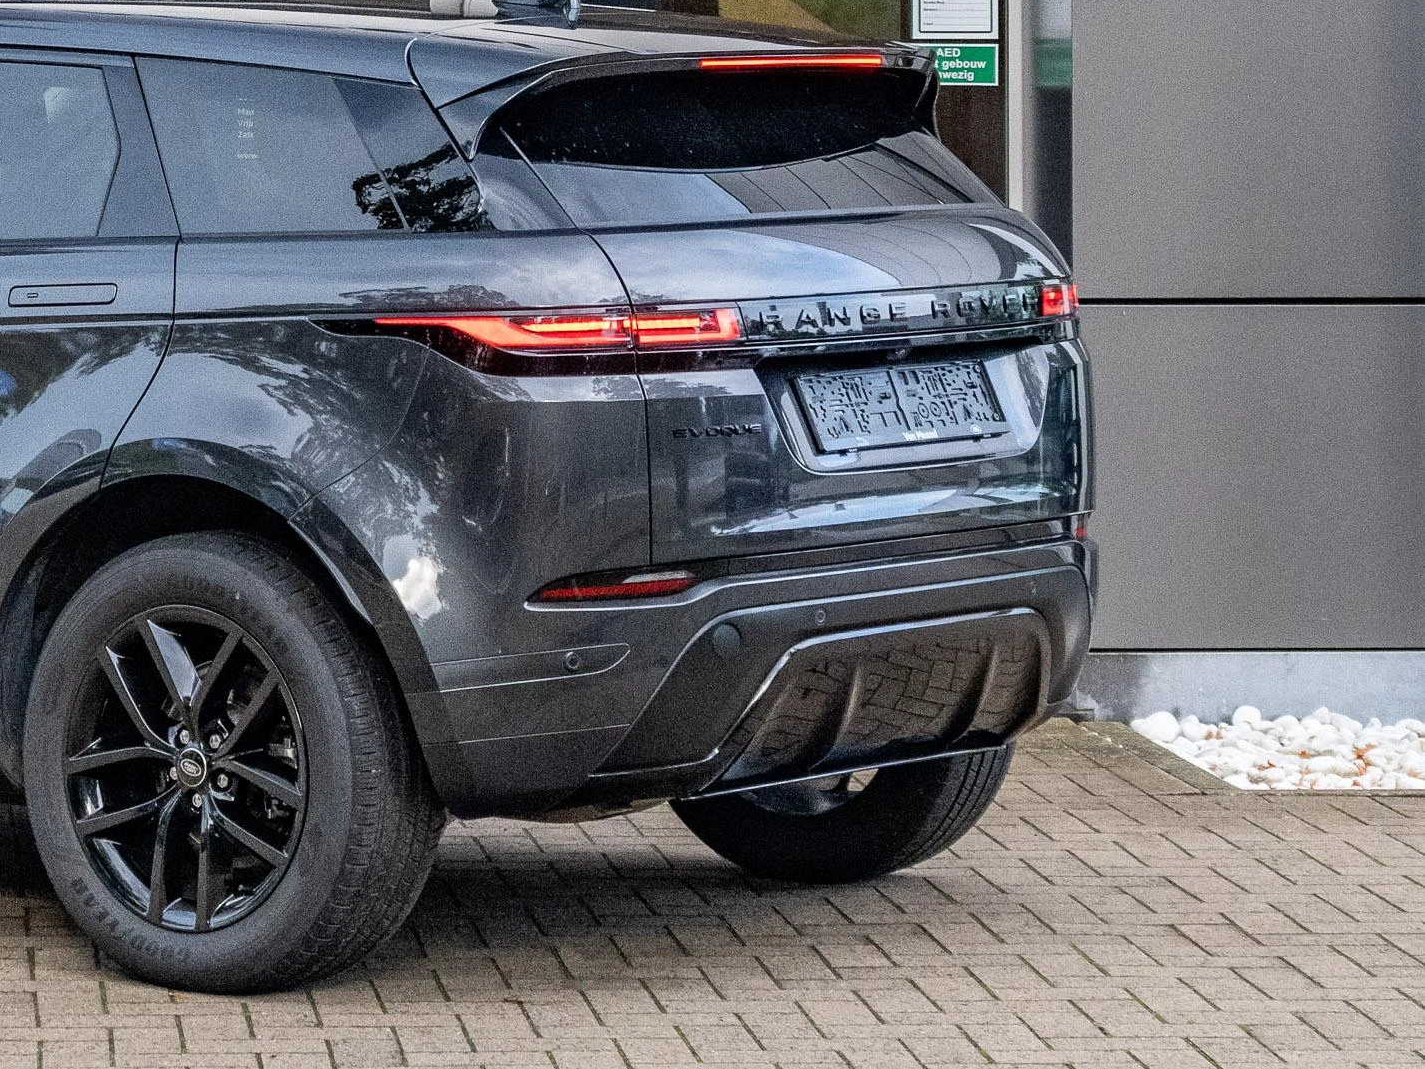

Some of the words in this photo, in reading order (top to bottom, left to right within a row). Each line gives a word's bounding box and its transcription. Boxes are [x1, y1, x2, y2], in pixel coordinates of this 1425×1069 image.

[936, 47, 961, 58] AED
[942, 59, 987, 71] gebouw
[759, 302, 907, 331] RANGE
[931, 290, 1039, 320] ROVER
[672, 423, 762, 439] EVOQUE
